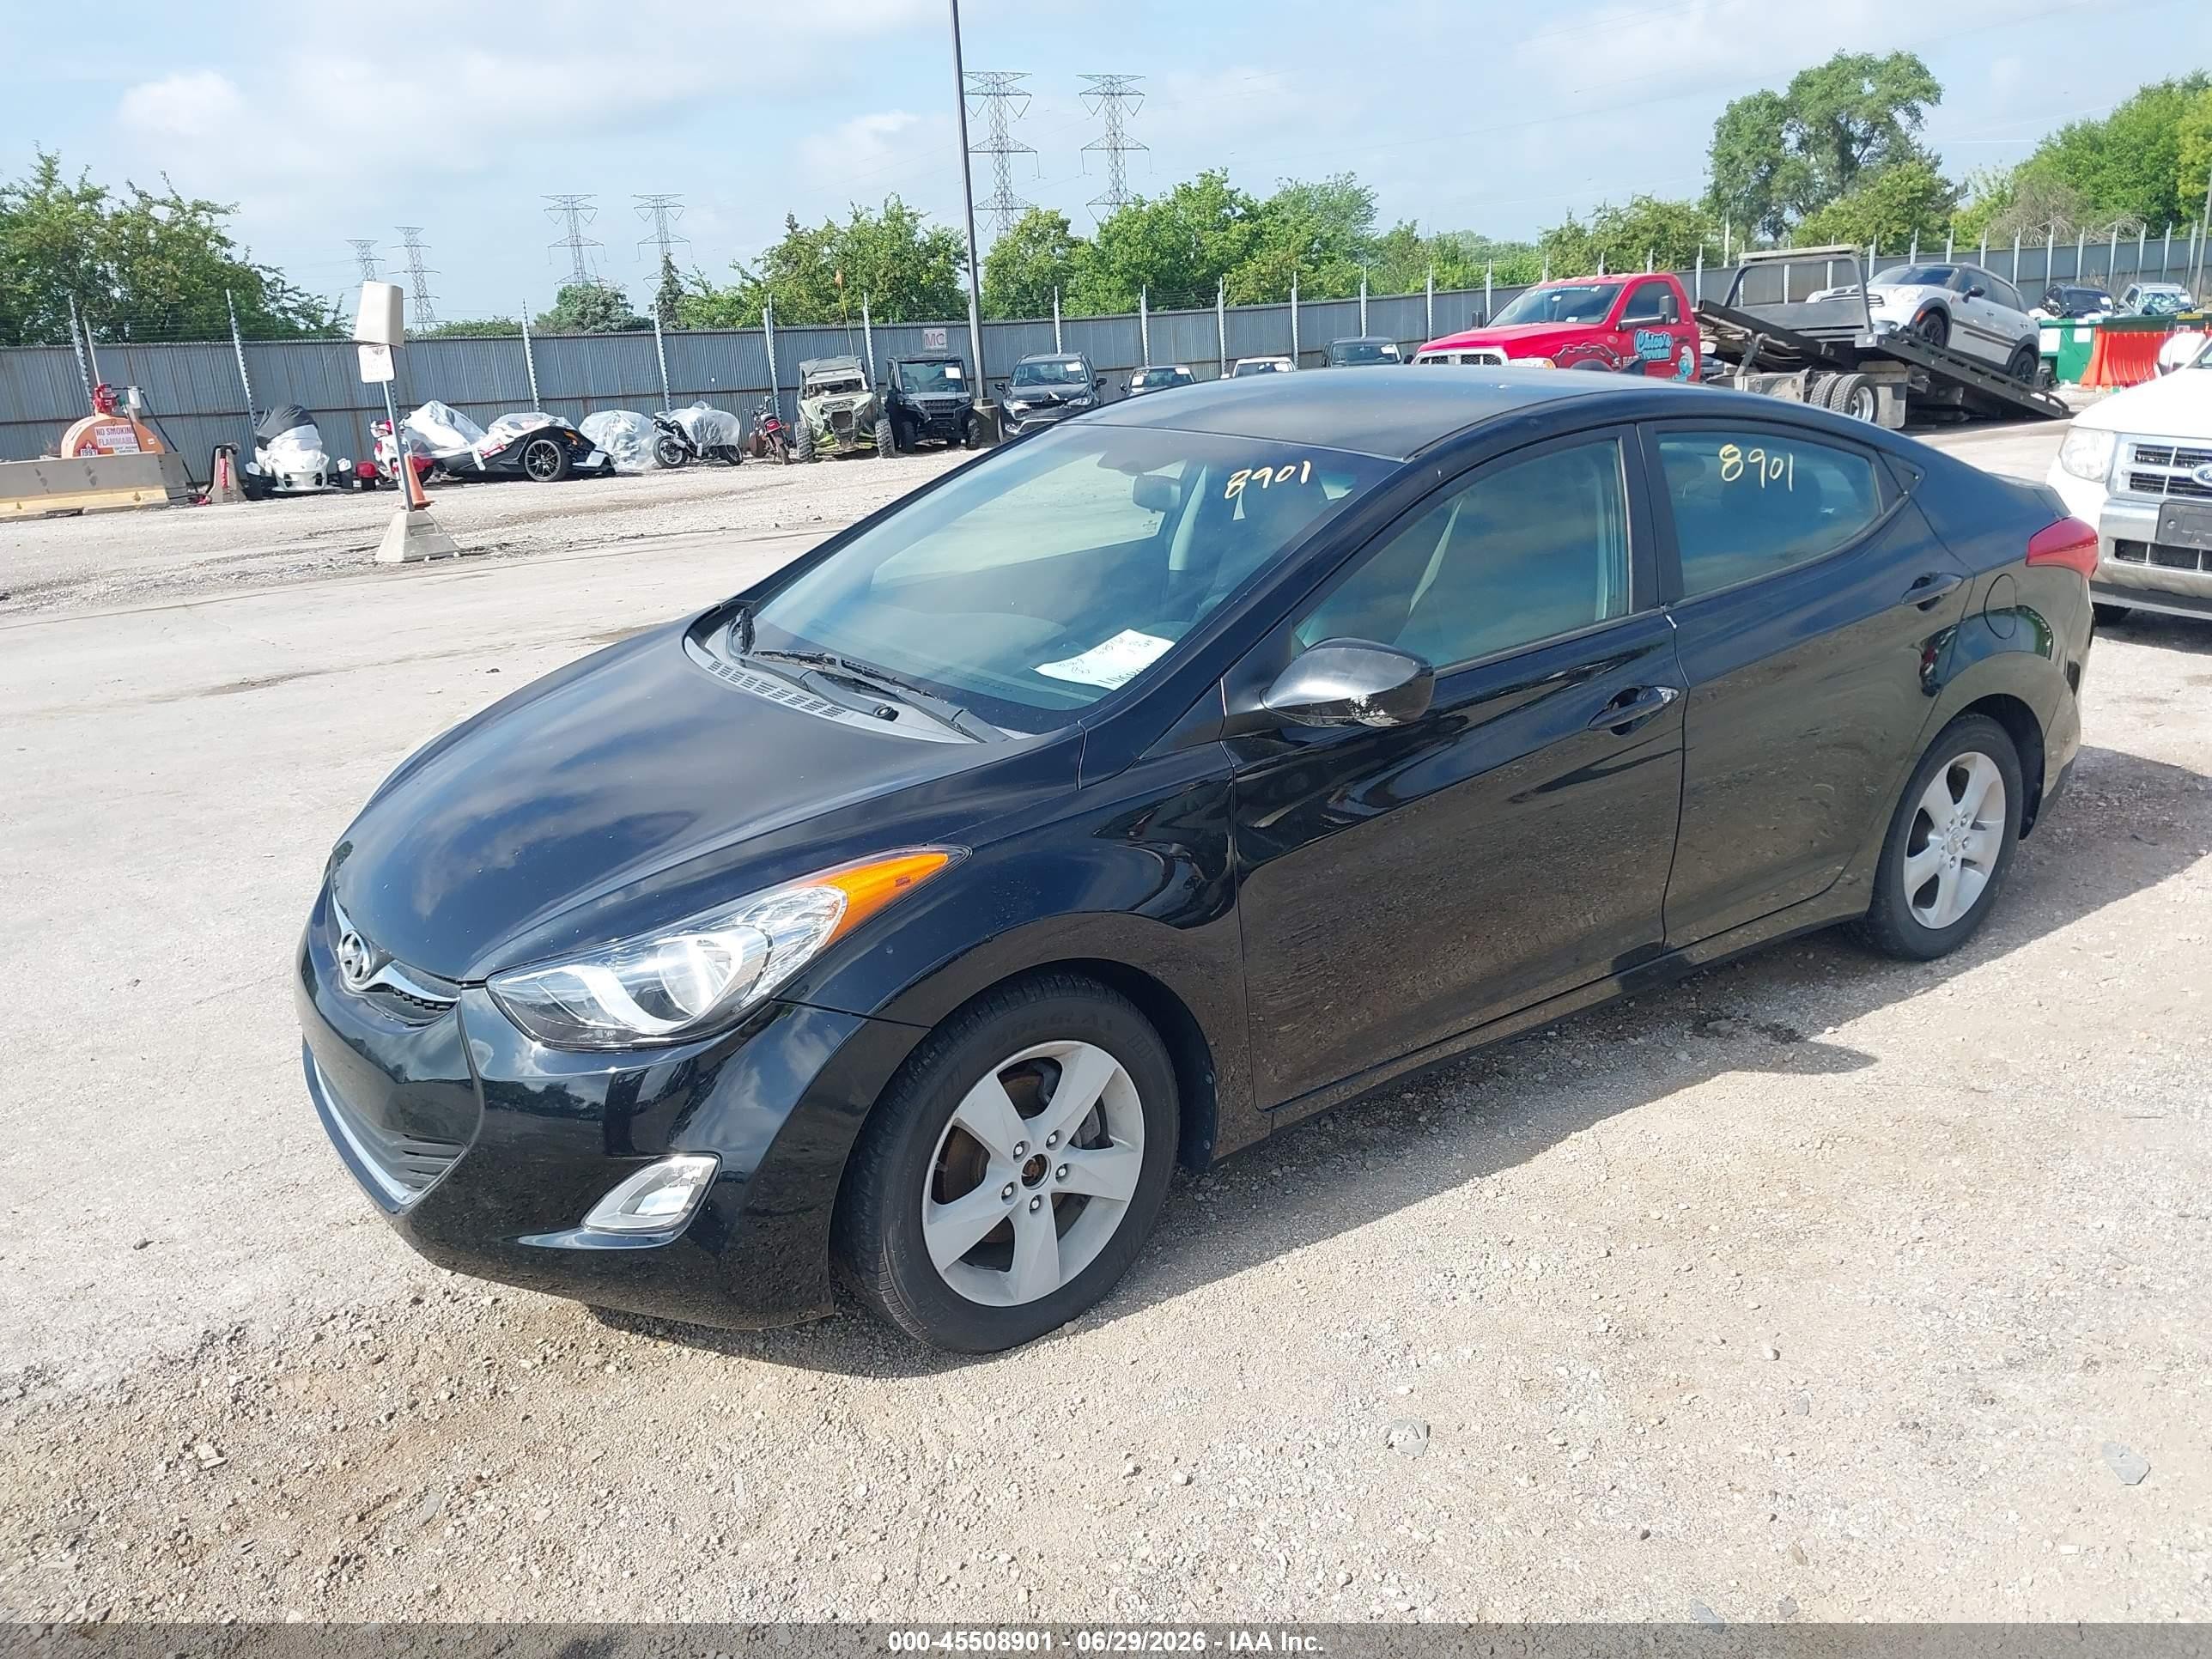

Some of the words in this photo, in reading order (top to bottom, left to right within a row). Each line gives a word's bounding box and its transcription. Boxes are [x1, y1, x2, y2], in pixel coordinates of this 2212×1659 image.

[925, 332, 945, 347] MC
[96, 428, 105, 436] NO
[1224, 460, 1311, 499] 8901
[1719, 444, 1793, 492] 8901
